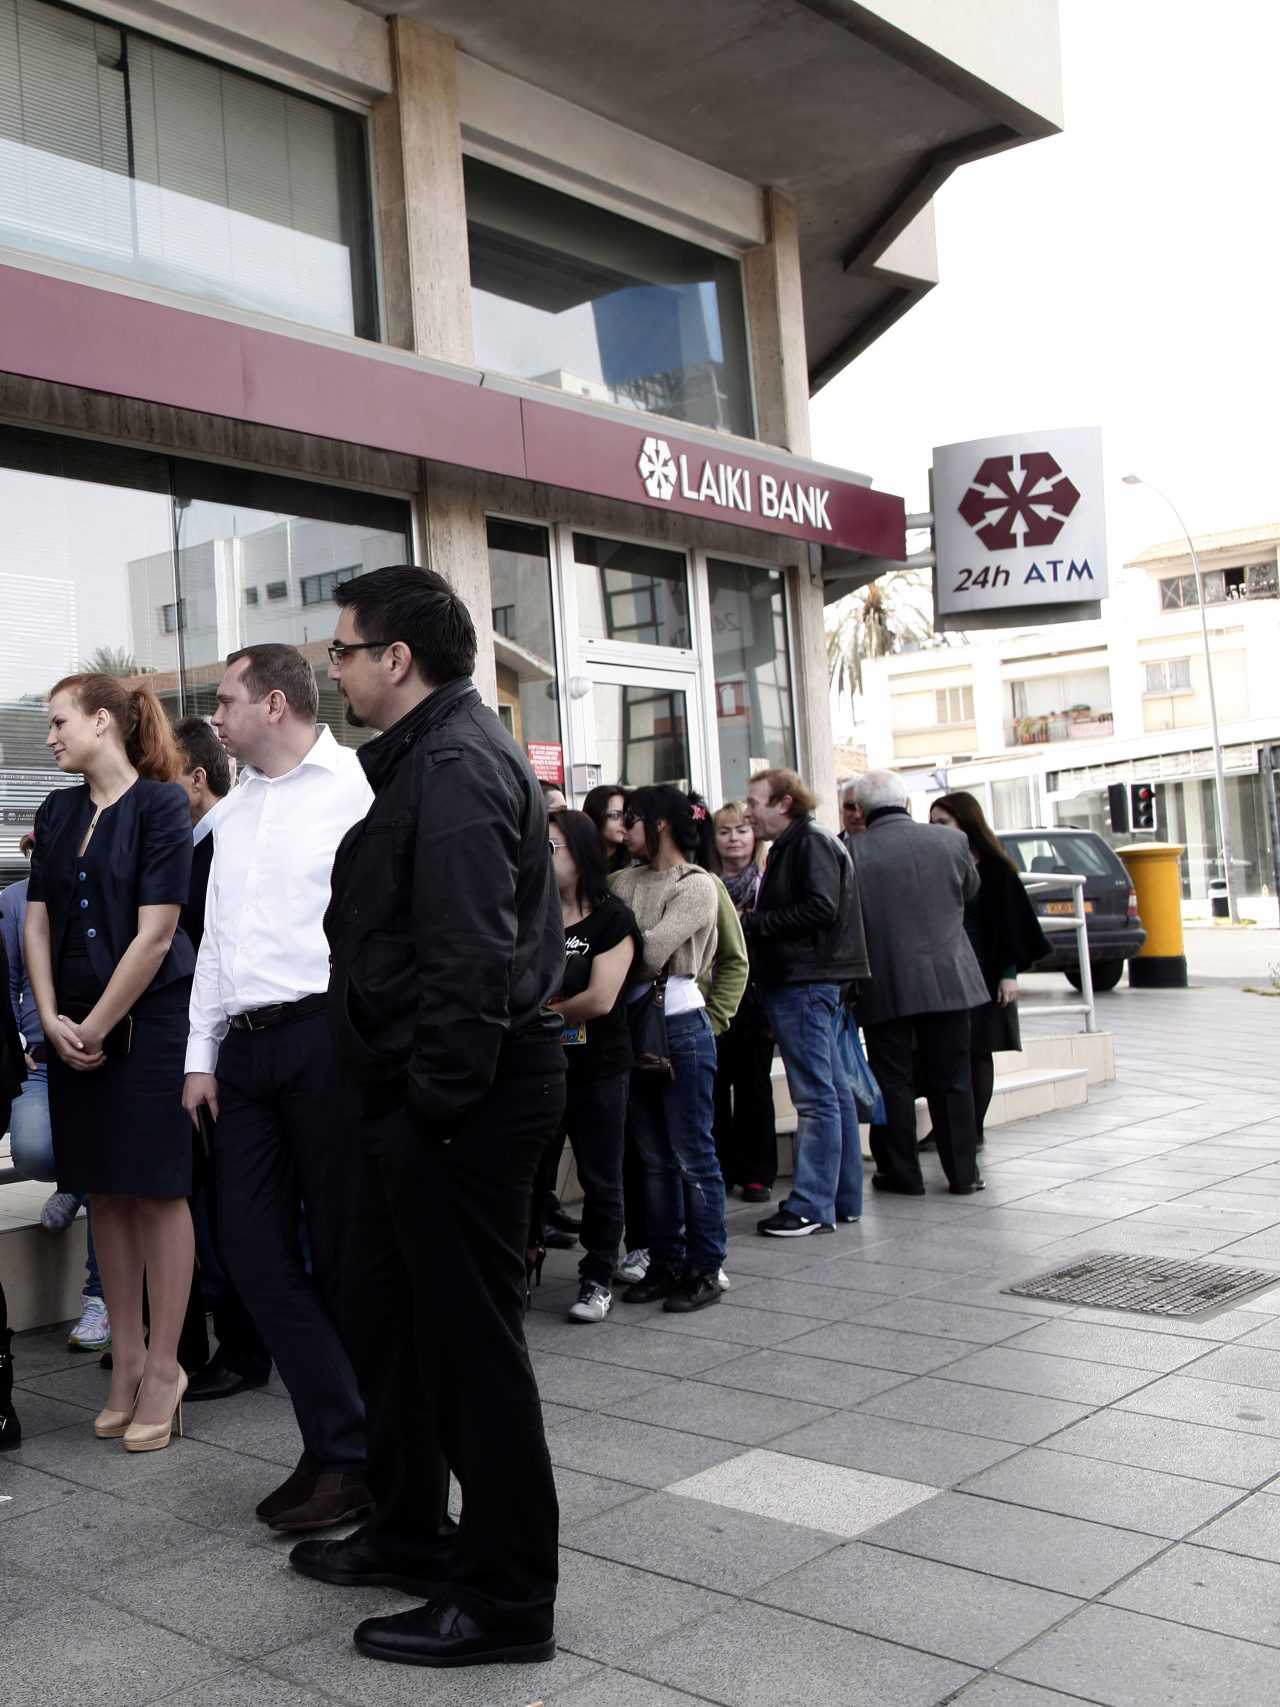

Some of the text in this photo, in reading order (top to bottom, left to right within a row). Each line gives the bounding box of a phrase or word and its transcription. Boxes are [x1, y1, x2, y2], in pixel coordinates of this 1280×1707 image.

[680, 454, 832, 531] LAIKI BANK
[952, 558, 1094, 593] 24h ATM
